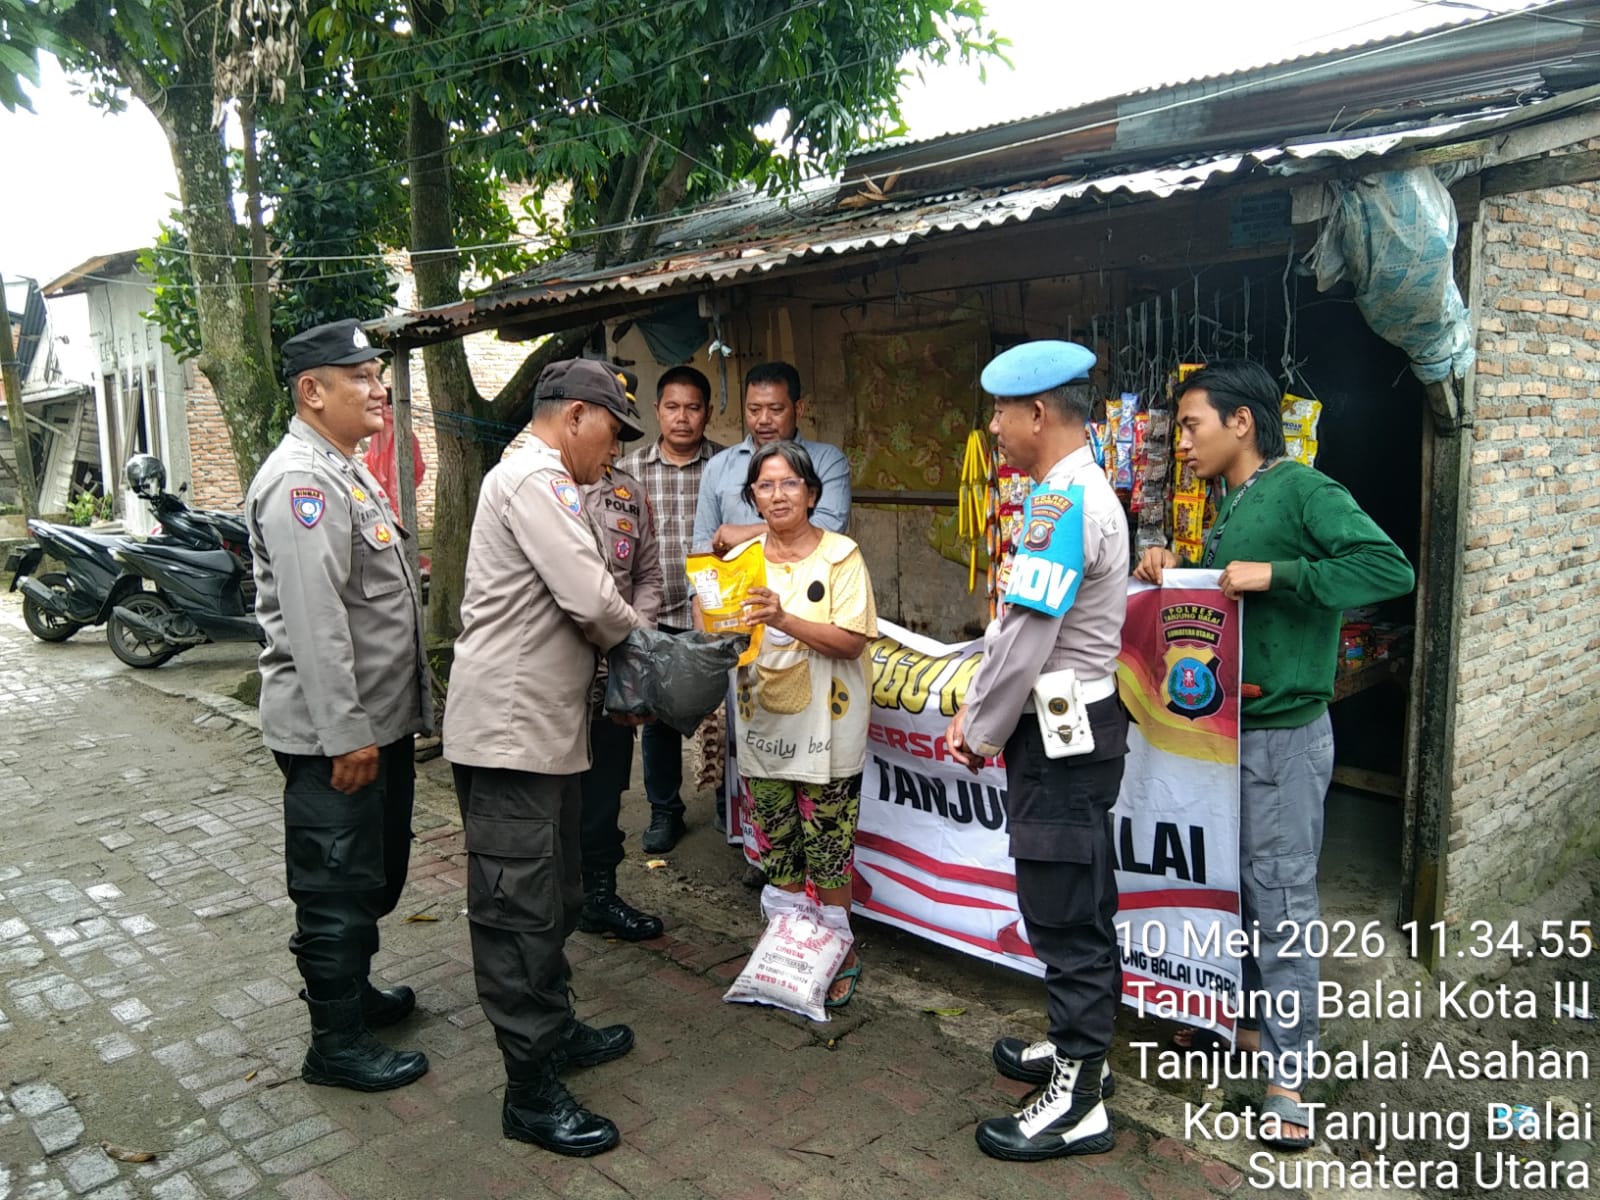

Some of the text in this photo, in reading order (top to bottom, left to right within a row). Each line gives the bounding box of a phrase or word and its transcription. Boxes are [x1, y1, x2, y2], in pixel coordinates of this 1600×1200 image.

[1168, 606, 1214, 615] POLRES
[745, 729, 797, 760] Easily
[1151, 957, 1191, 984] BALAI
[1196, 968, 1237, 1001] UTARA
